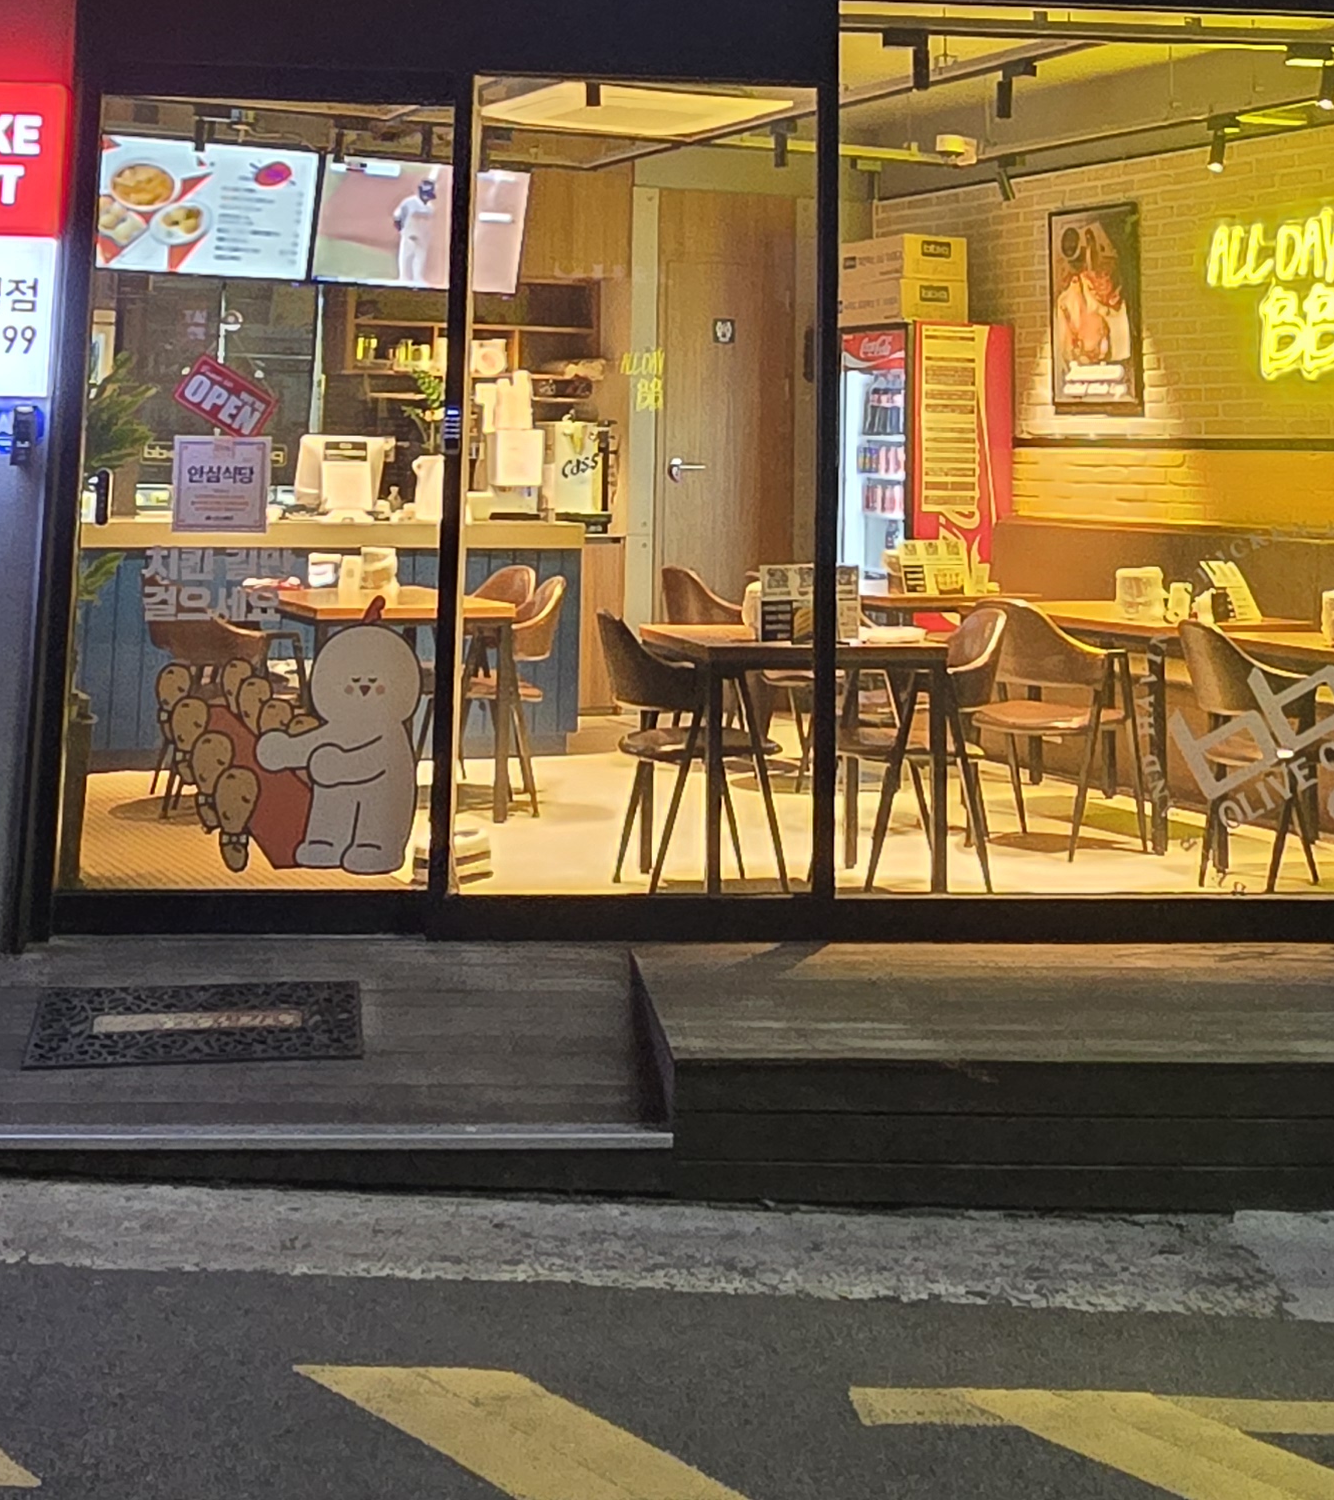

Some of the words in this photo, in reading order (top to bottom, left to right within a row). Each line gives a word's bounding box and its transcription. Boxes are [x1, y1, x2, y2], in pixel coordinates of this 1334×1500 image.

[1207, 222, 1273, 288] ALL
[184, 374, 262, 435] OPEN
[187, 465, 254, 484] 안심식당
[142, 585, 281, 621] 걸으세요
[1217, 754, 1318, 830] OLIVE
